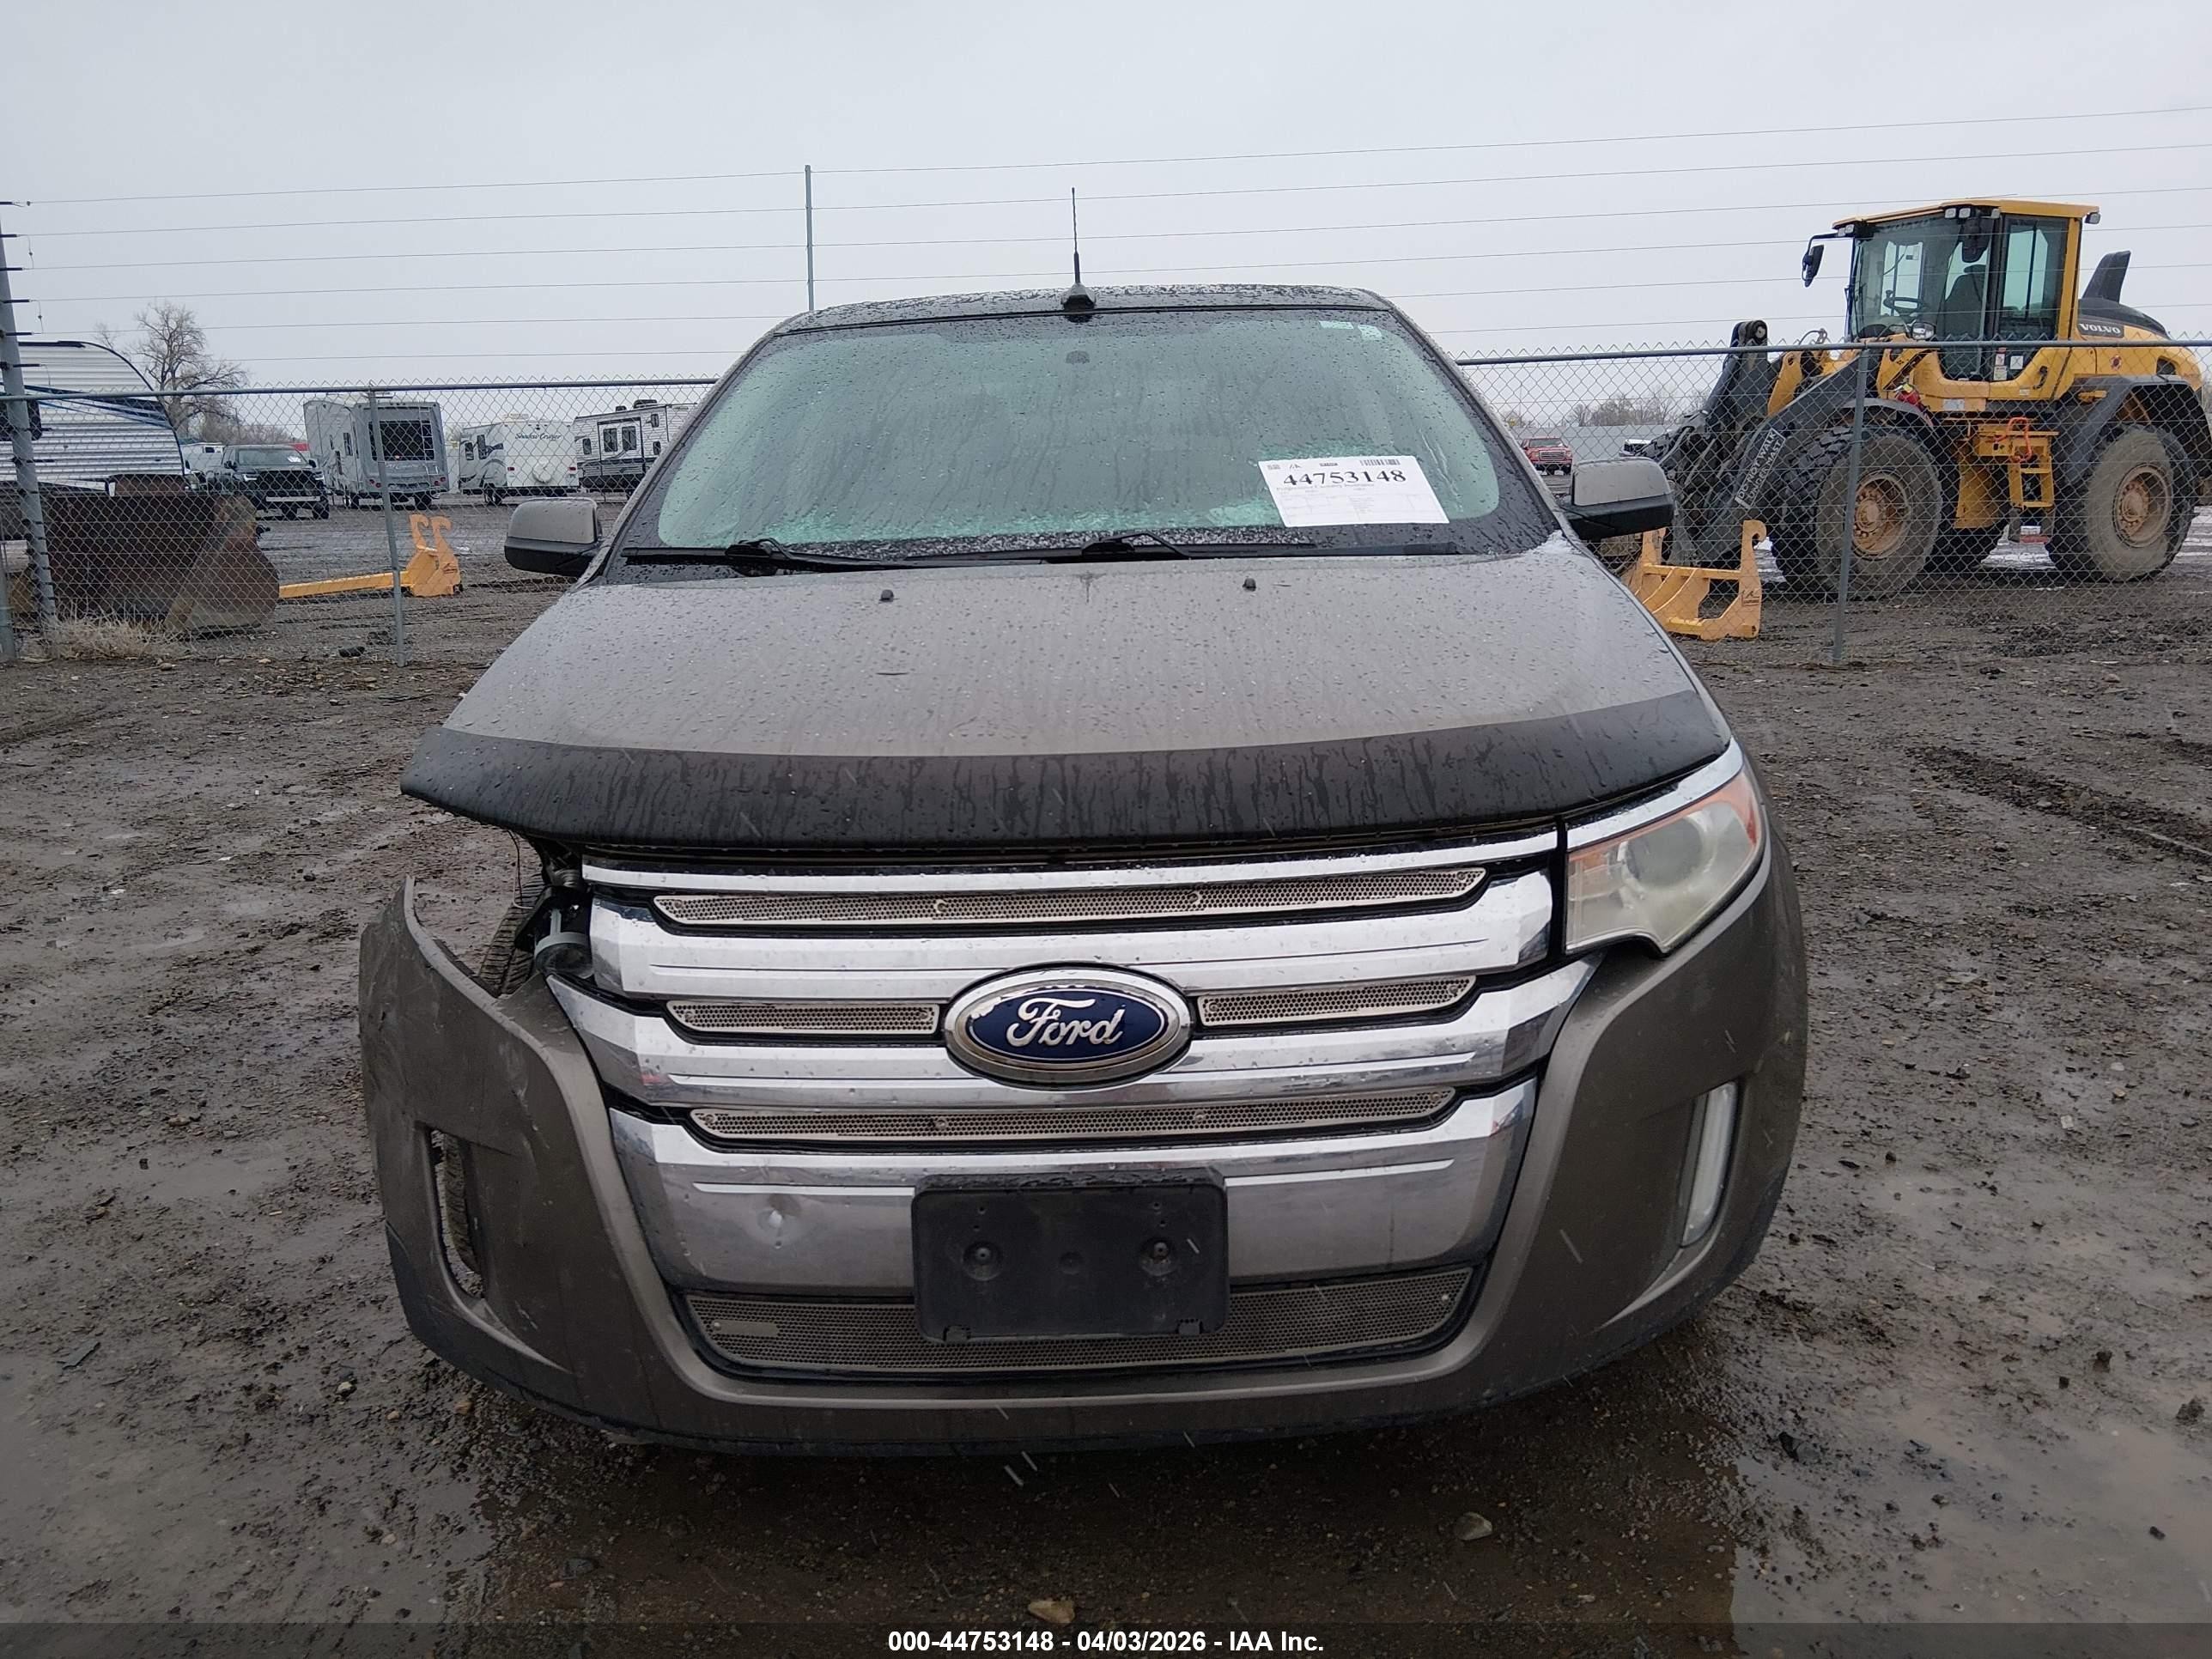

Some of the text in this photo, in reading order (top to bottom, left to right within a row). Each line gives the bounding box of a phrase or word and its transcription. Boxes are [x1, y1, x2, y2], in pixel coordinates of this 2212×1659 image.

[2079, 323, 2121, 334] VOLVO
[1284, 470, 1407, 486] 44753148
[1738, 431, 1777, 499] DO NOT WALK
[1748, 439, 1782, 498] UNDER MAST
[1006, 997, 1127, 1048] Ford
